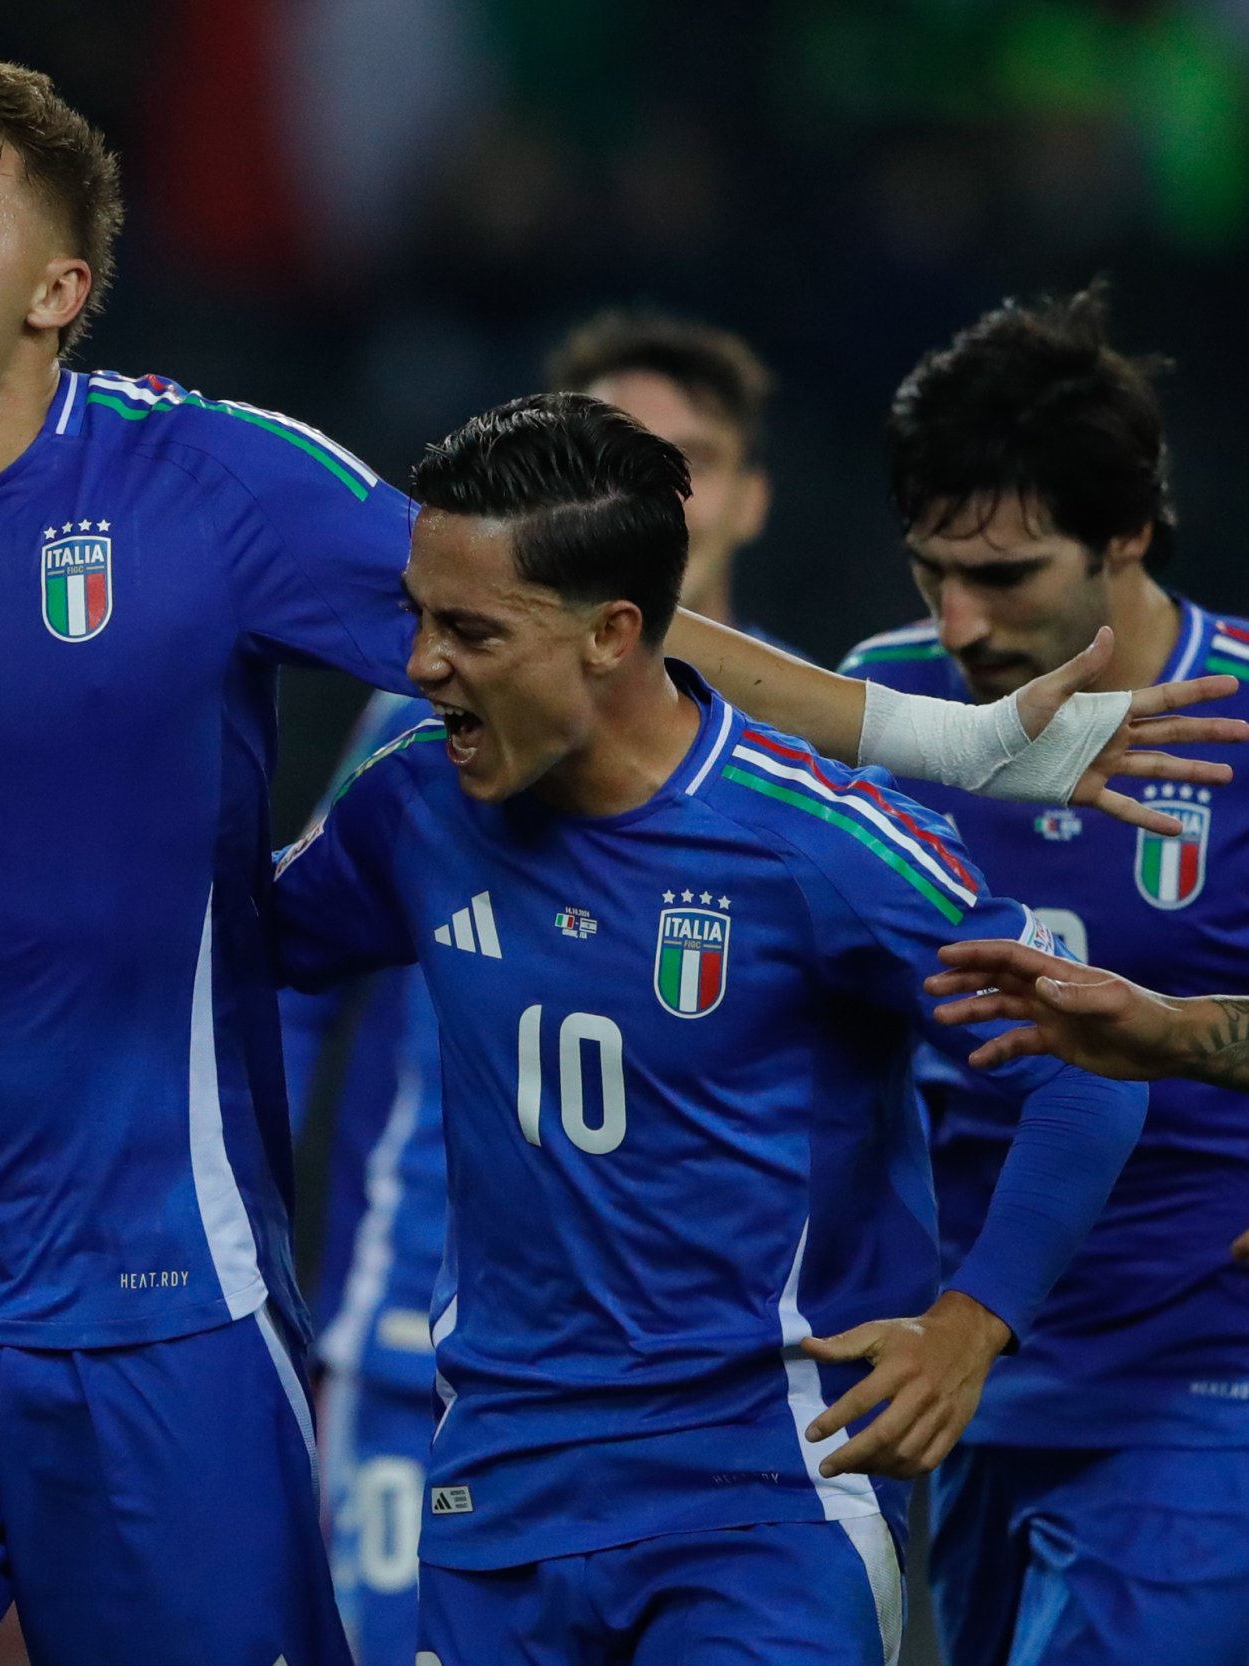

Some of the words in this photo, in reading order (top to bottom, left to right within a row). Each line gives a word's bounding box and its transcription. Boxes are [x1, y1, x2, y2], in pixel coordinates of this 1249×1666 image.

[47, 544, 105, 569] ITALIA
[66, 565, 84, 575] FIGC
[664, 916, 723, 942] ITALIA
[683, 940, 702, 950] FIGC
[518, 1004, 627, 1155] 10
[120, 1271, 189, 1289] HEAT.RDY
